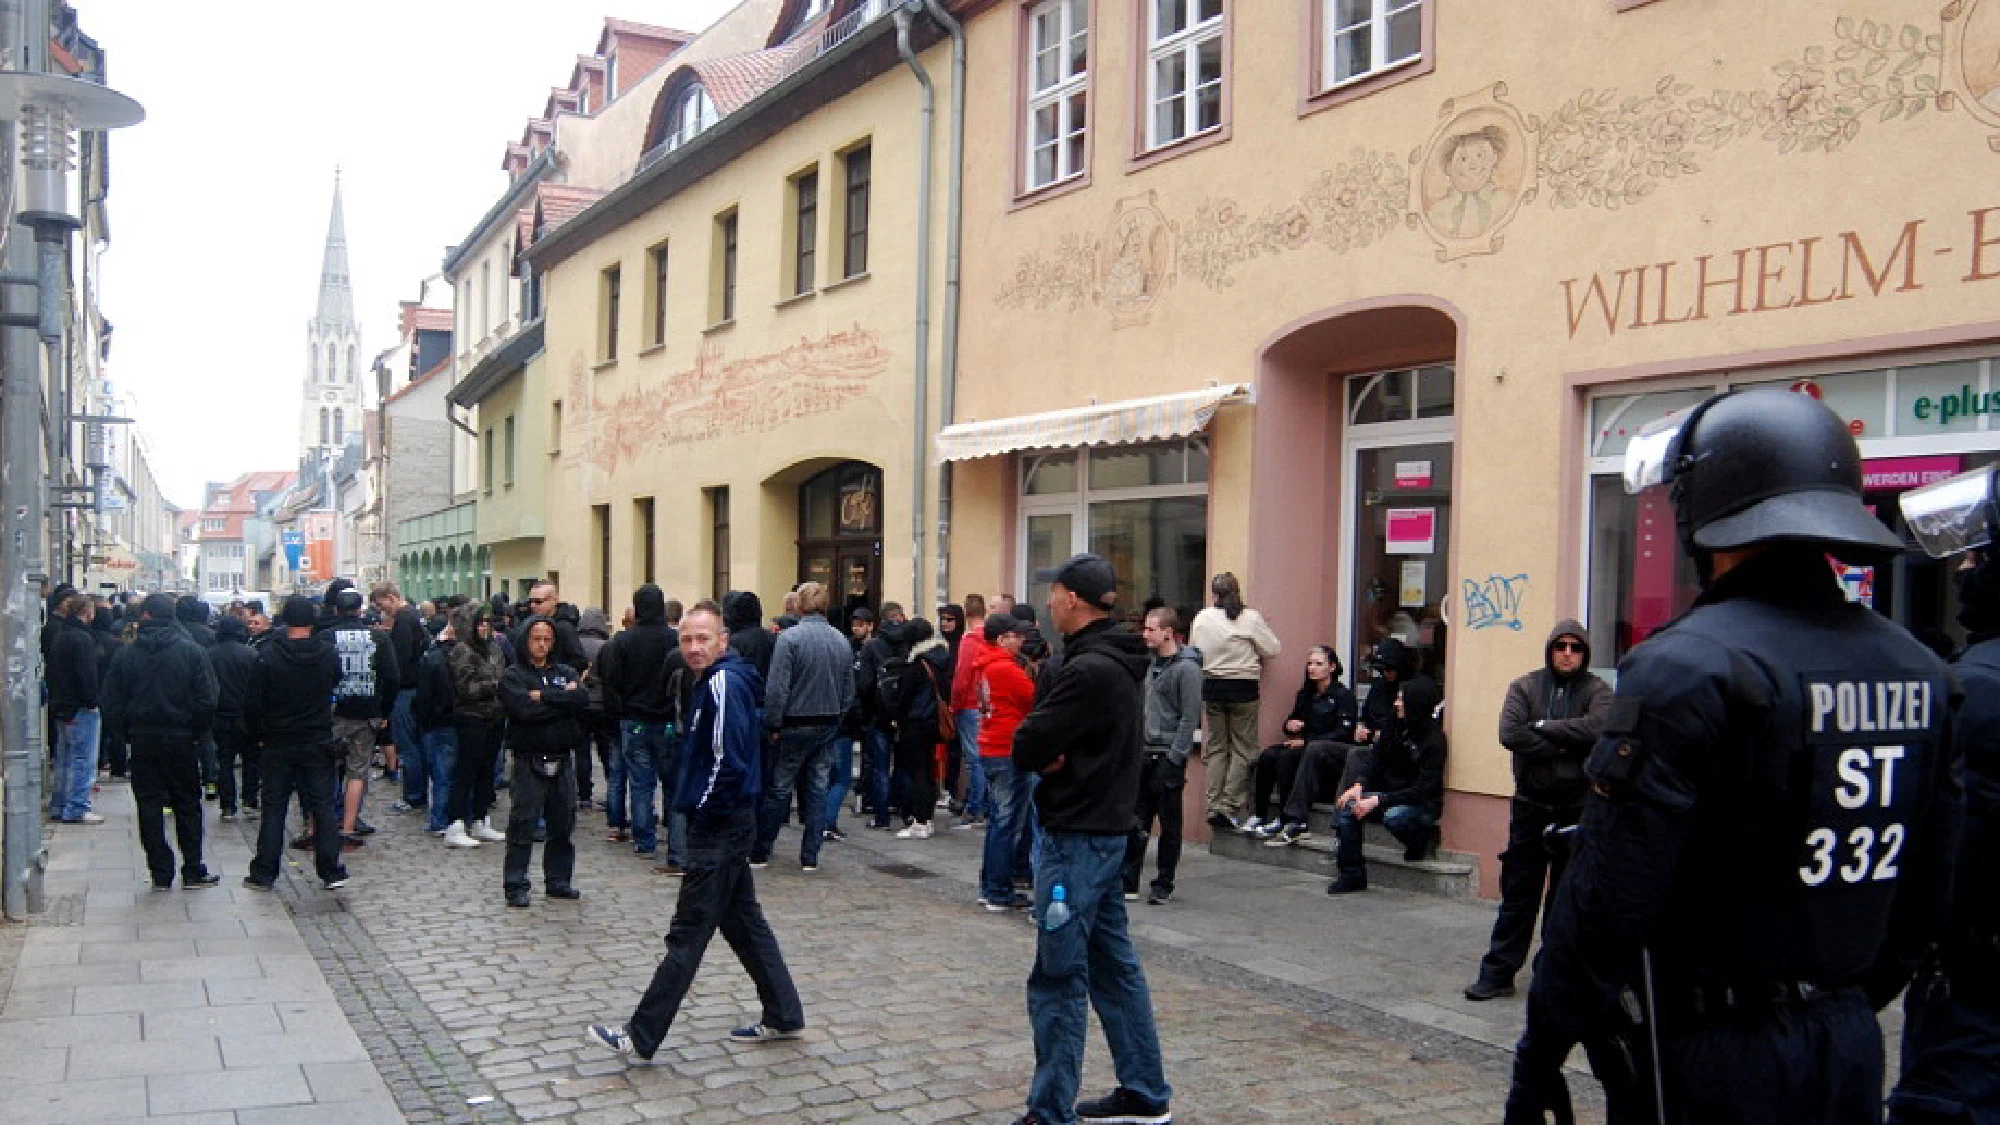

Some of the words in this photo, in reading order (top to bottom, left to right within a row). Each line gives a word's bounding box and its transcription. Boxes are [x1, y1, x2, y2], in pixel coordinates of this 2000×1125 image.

[1809, 681, 1931, 732] POLIZEI
[1834, 745, 1905, 809] ST
[1798, 823, 1905, 887] 332
